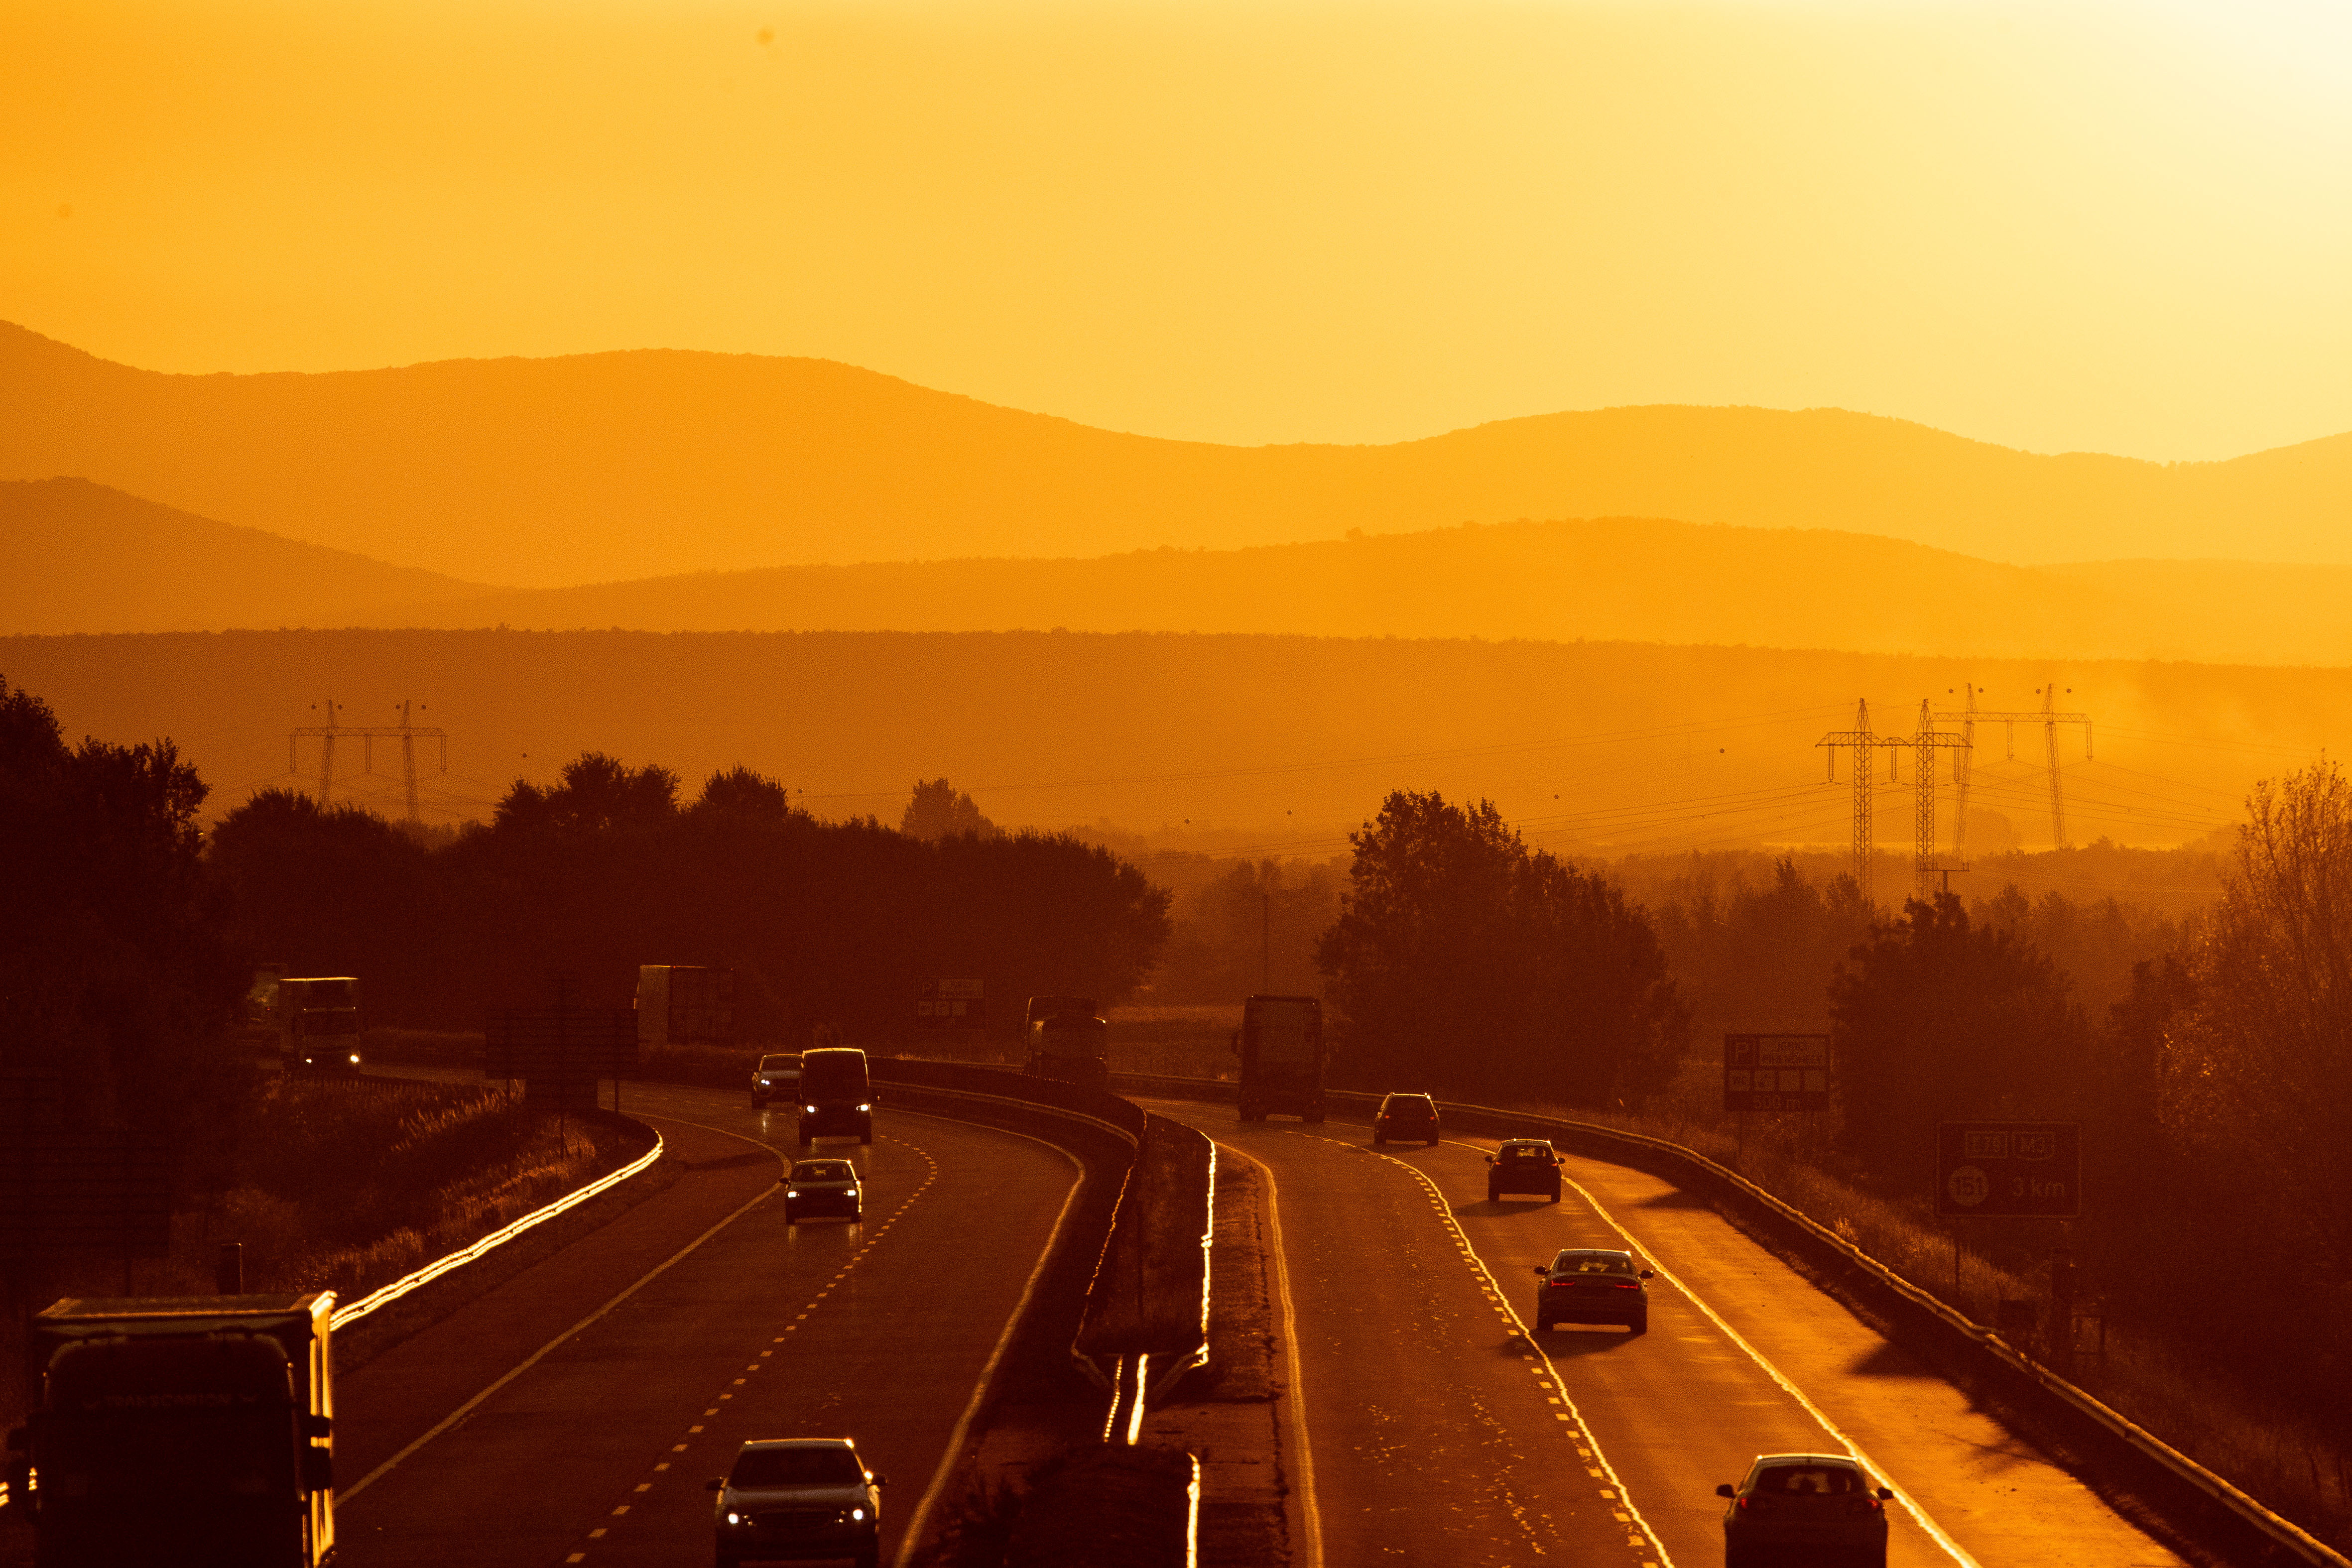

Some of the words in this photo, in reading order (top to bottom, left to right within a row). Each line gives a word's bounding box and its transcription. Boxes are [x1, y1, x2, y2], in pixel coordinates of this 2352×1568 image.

[1735, 1041, 1749, 1063] P
[1753, 1094, 1781, 1109] 500
[1786, 1098, 1802, 1110] m
[2020, 1136, 2045, 1153] M3
[1955, 1176, 1983, 1196] 151
[2012, 1177, 2024, 1197] 3
[2030, 1177, 2065, 1197] km
